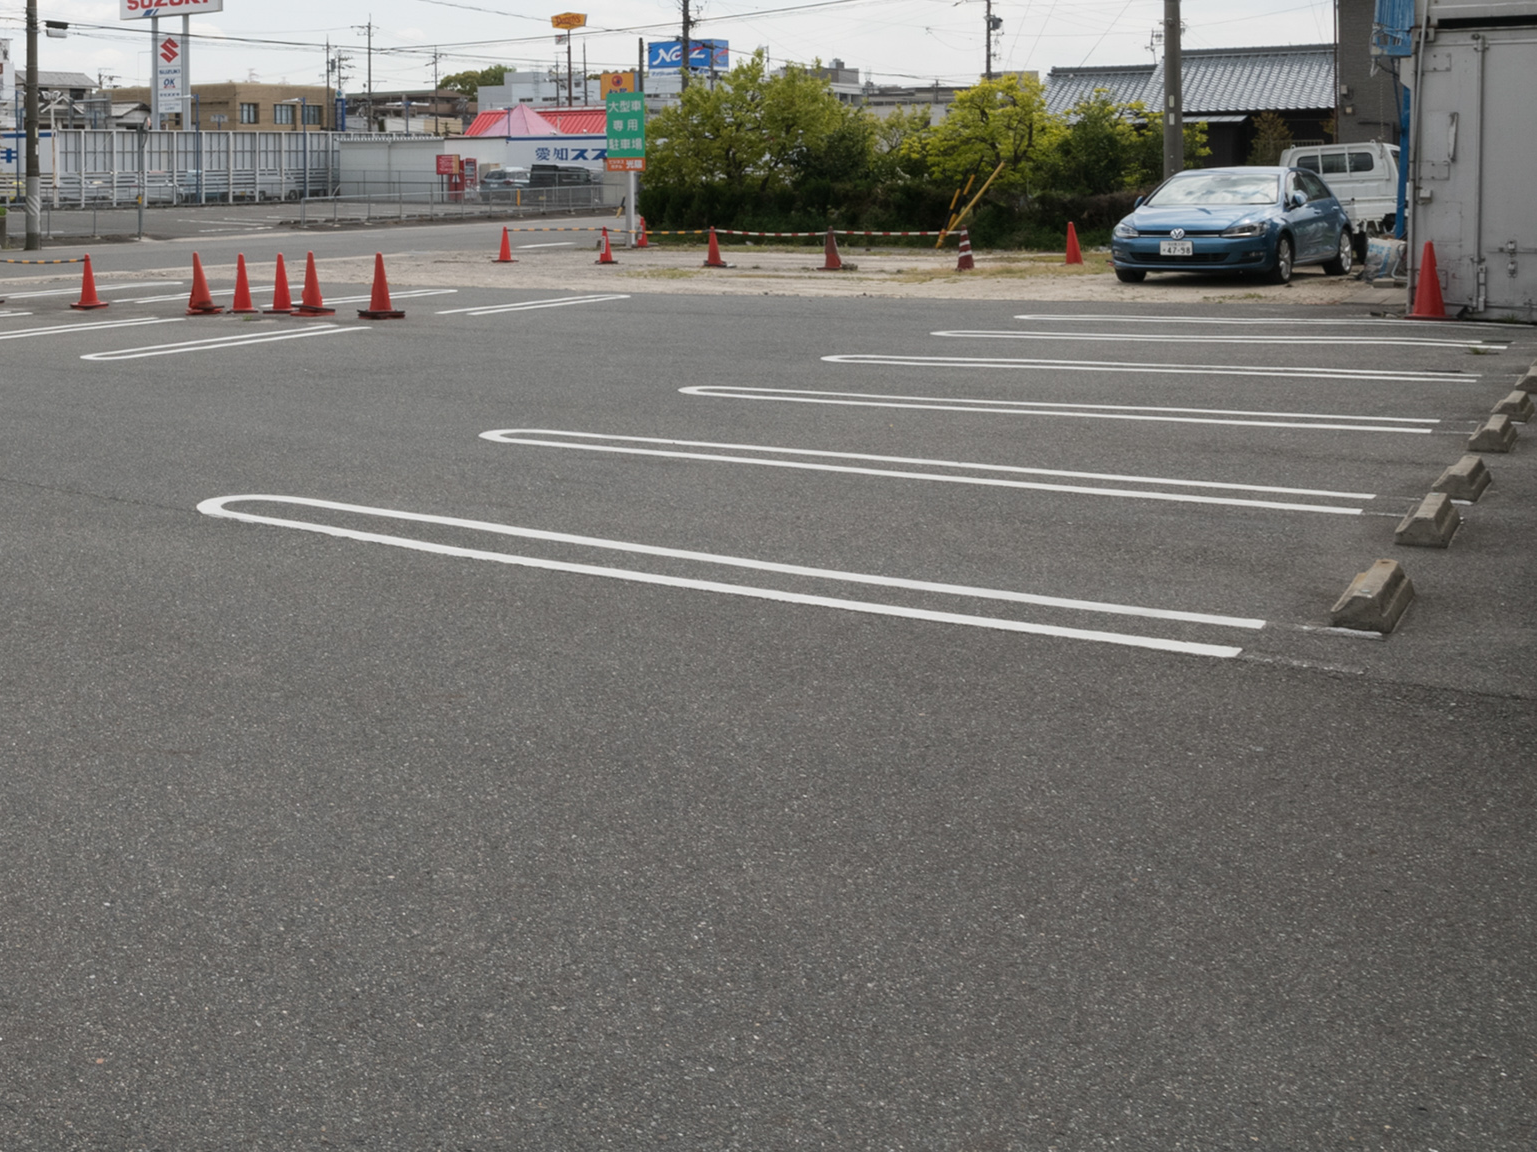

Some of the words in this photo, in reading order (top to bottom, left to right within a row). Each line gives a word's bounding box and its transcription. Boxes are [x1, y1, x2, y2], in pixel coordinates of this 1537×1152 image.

[163, 78, 175, 86] OK
[608, 100, 642, 113] 大型車
[613, 119, 638, 132] 専用
[608, 138, 643, 151] 駐車場
